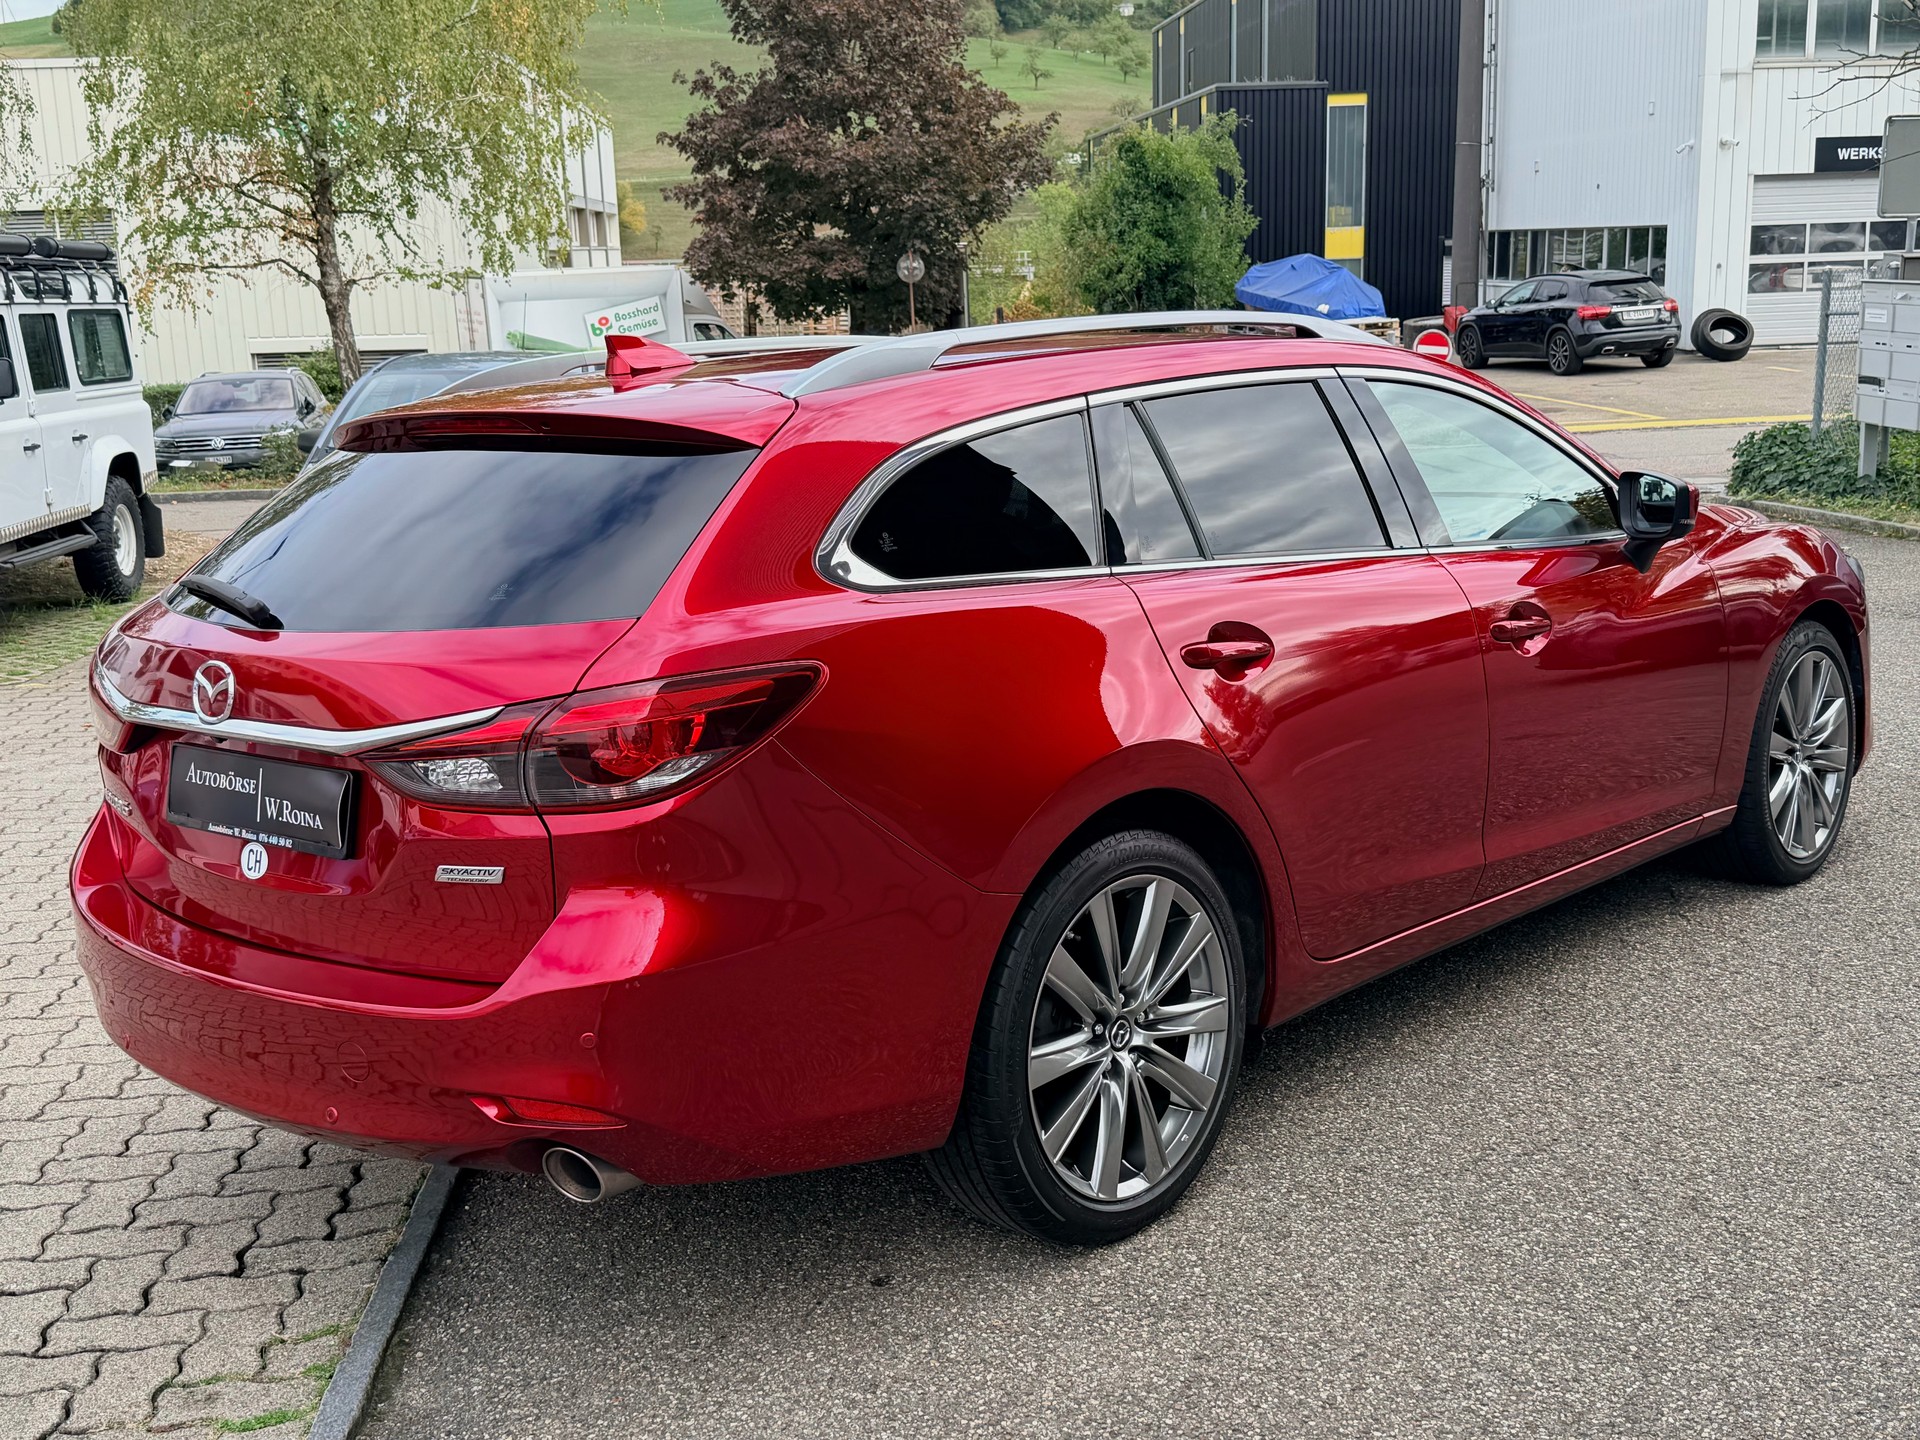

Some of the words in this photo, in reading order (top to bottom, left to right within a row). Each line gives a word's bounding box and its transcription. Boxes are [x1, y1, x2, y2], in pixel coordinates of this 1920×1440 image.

[614, 302, 659, 323] Bosshard
[618, 318, 659, 334] Gemüse
[186, 762, 257, 795] AUTOBÖRSE
[208, 823, 234, 836] Autobörse
[242, 829, 257, 841] Roina
[259, 833, 268, 843] 076
[247, 848, 262, 874] CH
[441, 868, 496, 876] SKYACTIV
